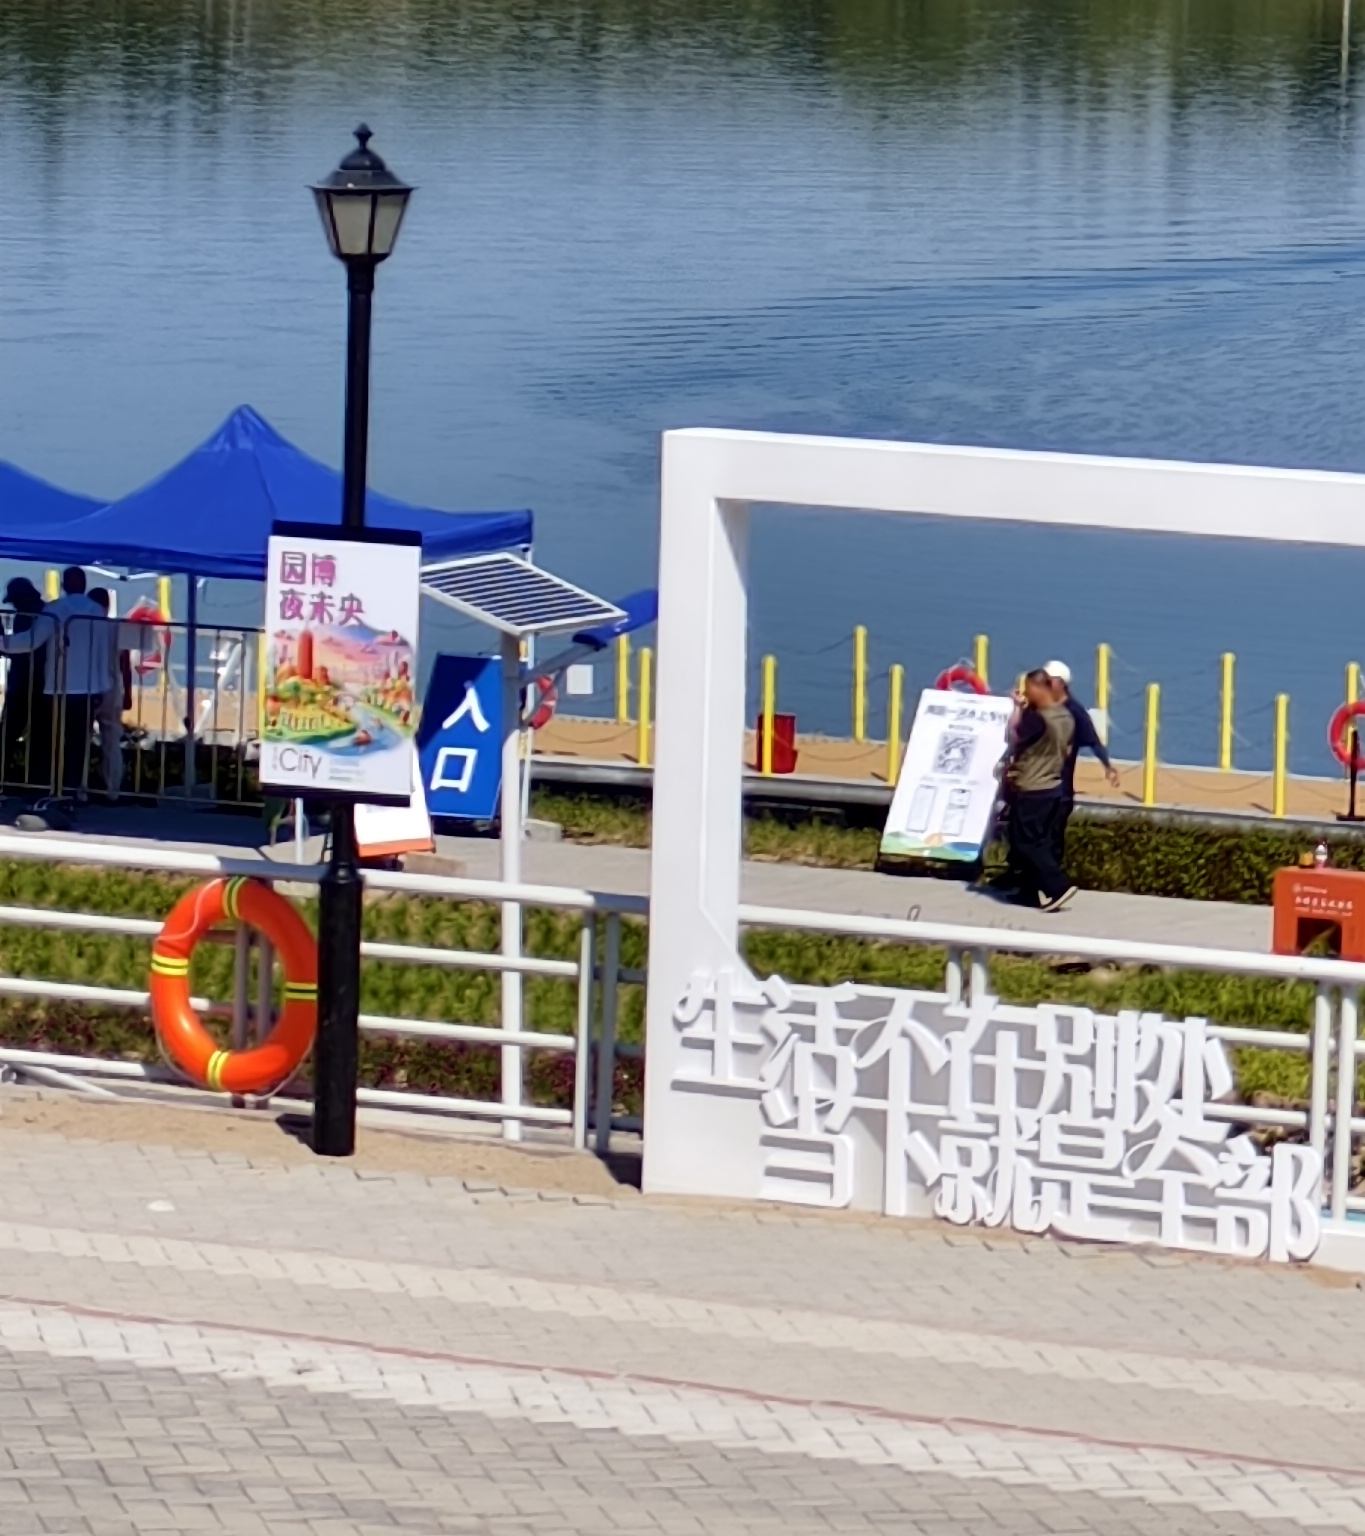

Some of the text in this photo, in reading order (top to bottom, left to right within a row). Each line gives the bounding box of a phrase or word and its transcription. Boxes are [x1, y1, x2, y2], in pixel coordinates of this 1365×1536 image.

[279, 588, 365, 626] 夜未央
[280, 551, 337, 587] 园博
[430, 680, 491, 793] 入口
[670, 970, 1235, 1140] 生活不在别处
[757, 1089, 1322, 1262] 当下就是全部
